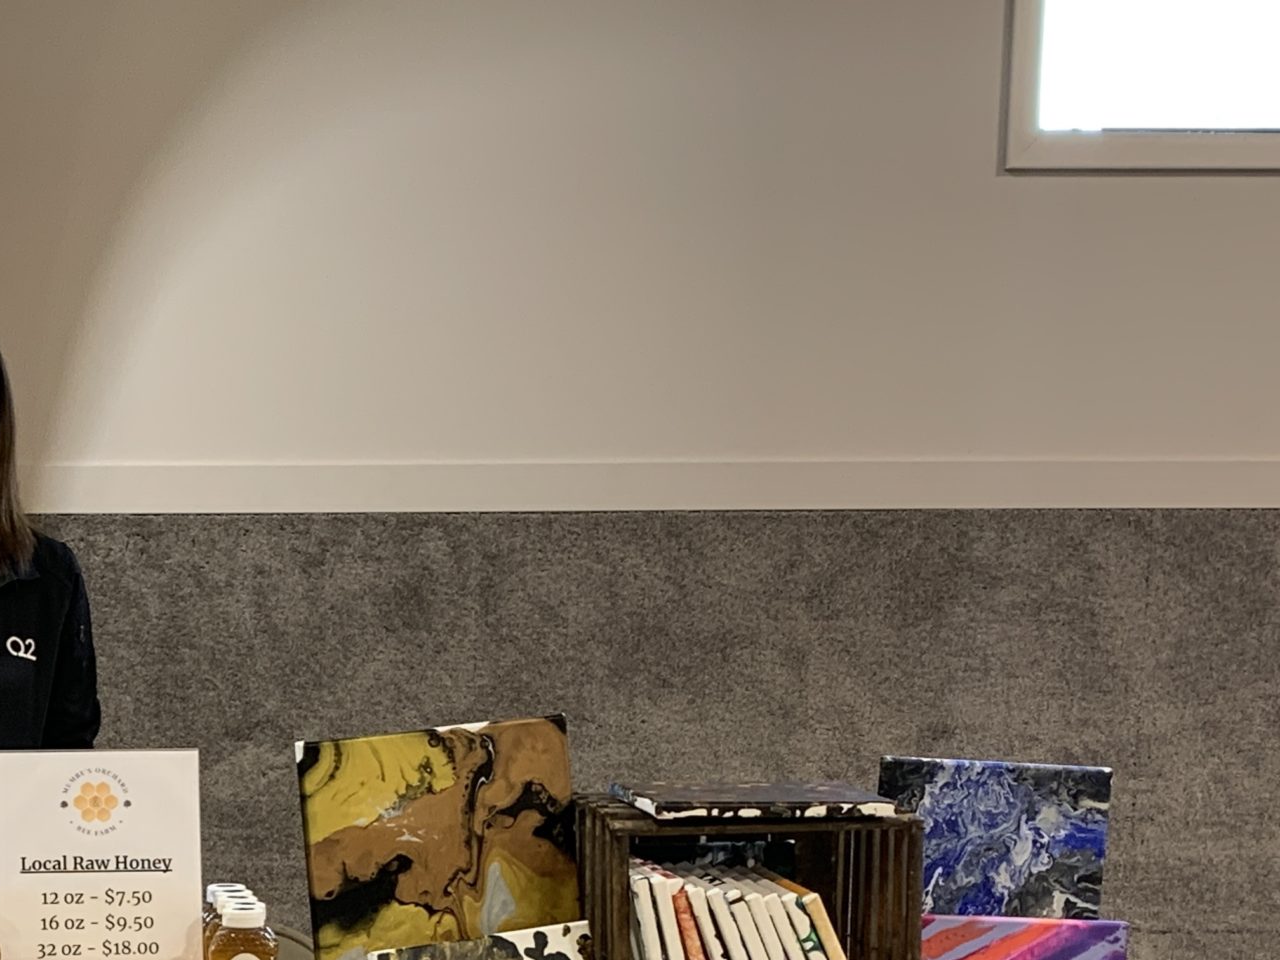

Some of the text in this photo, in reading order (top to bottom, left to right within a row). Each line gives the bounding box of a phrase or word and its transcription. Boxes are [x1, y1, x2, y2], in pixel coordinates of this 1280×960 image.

[6, 636, 37, 661] Q2
[20, 854, 173, 873] Local Raw Honey
[41, 892, 60, 905] 12
[64, 892, 85, 905] oz
[104, 887, 152, 907] $7.50
[40, 915, 59, 931] 16
[64, 918, 85, 930] oz
[105, 913, 154, 932] $9.50
[37, 943, 57, 960] 32
[61, 944, 82, 956] oz
[102, 939, 159, 957] $18.00
